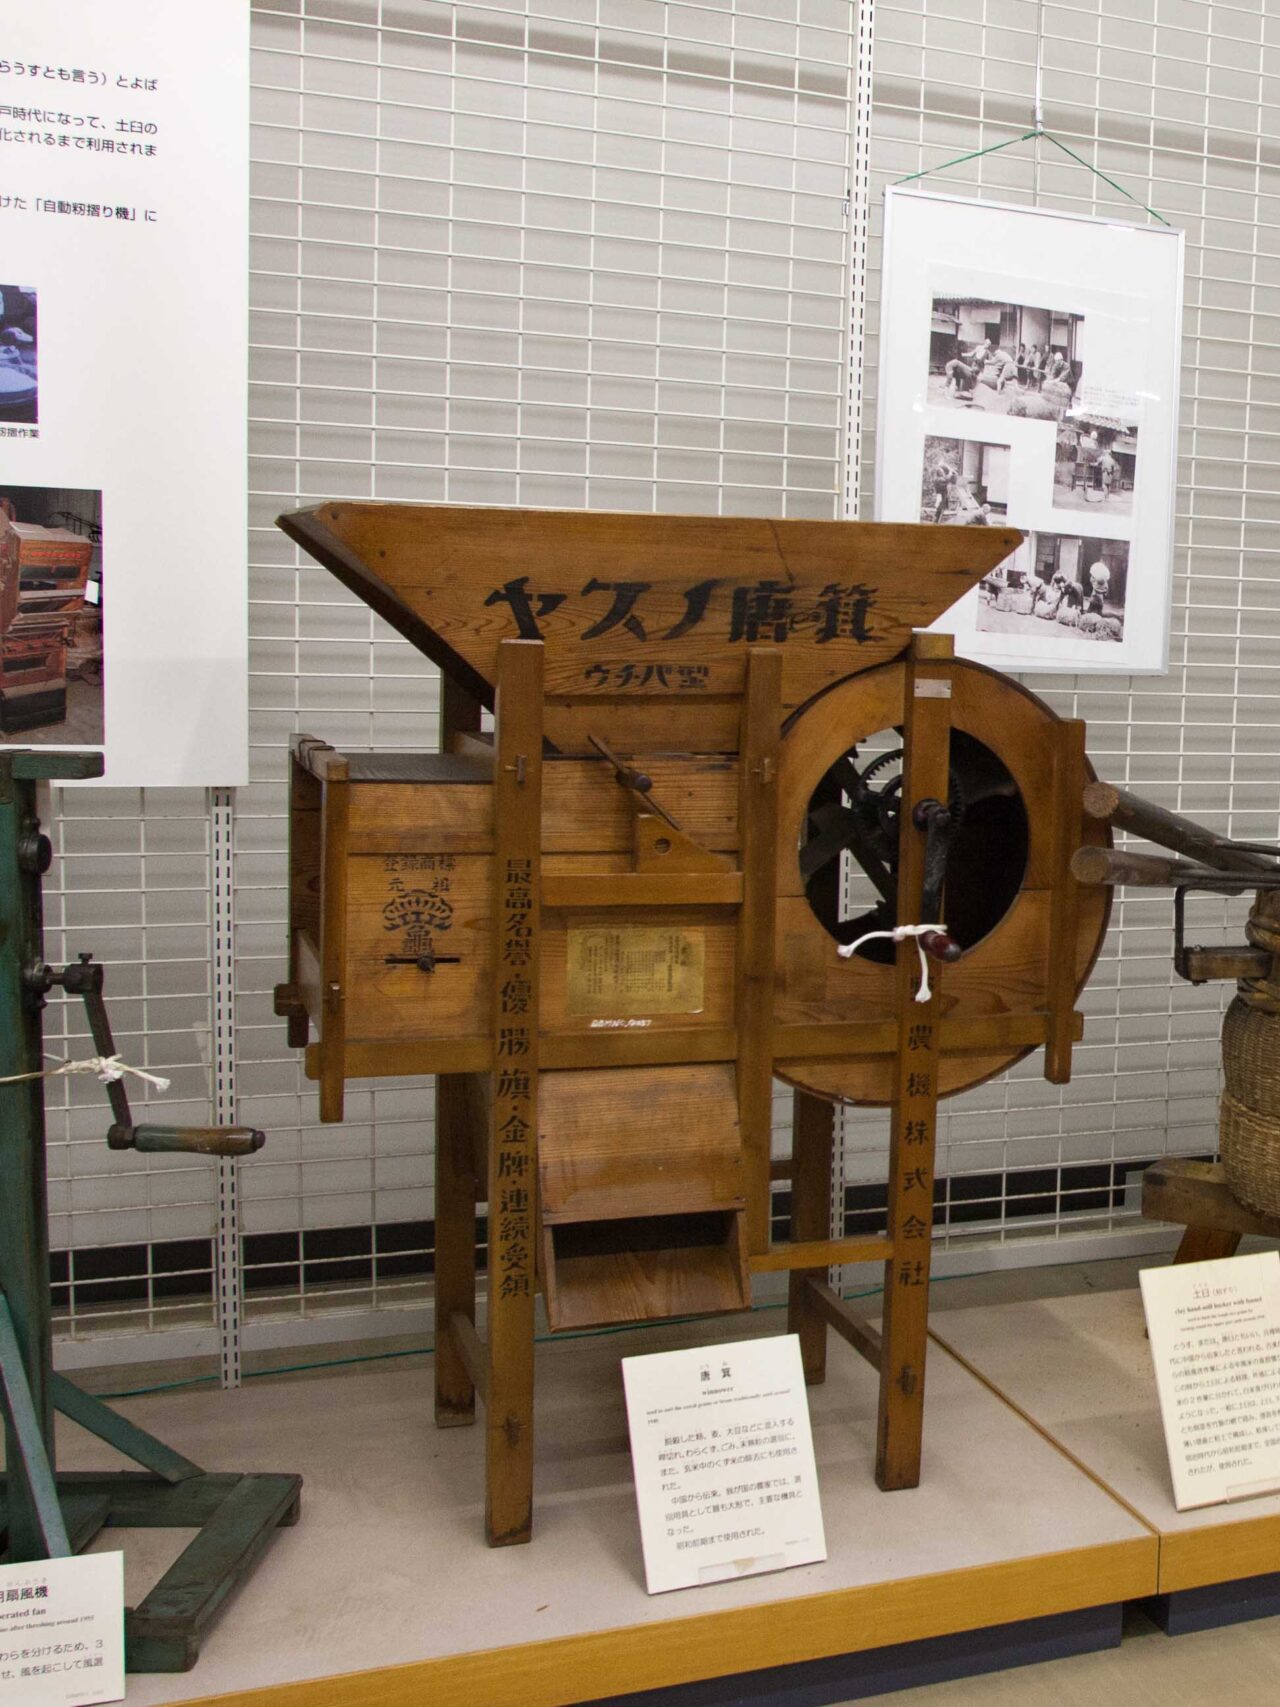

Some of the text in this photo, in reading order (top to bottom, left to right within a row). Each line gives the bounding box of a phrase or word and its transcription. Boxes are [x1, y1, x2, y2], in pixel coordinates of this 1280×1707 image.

[484, 575, 884, 644] ヤスノ唐箕
[32, 1607, 47, 1616] fan
